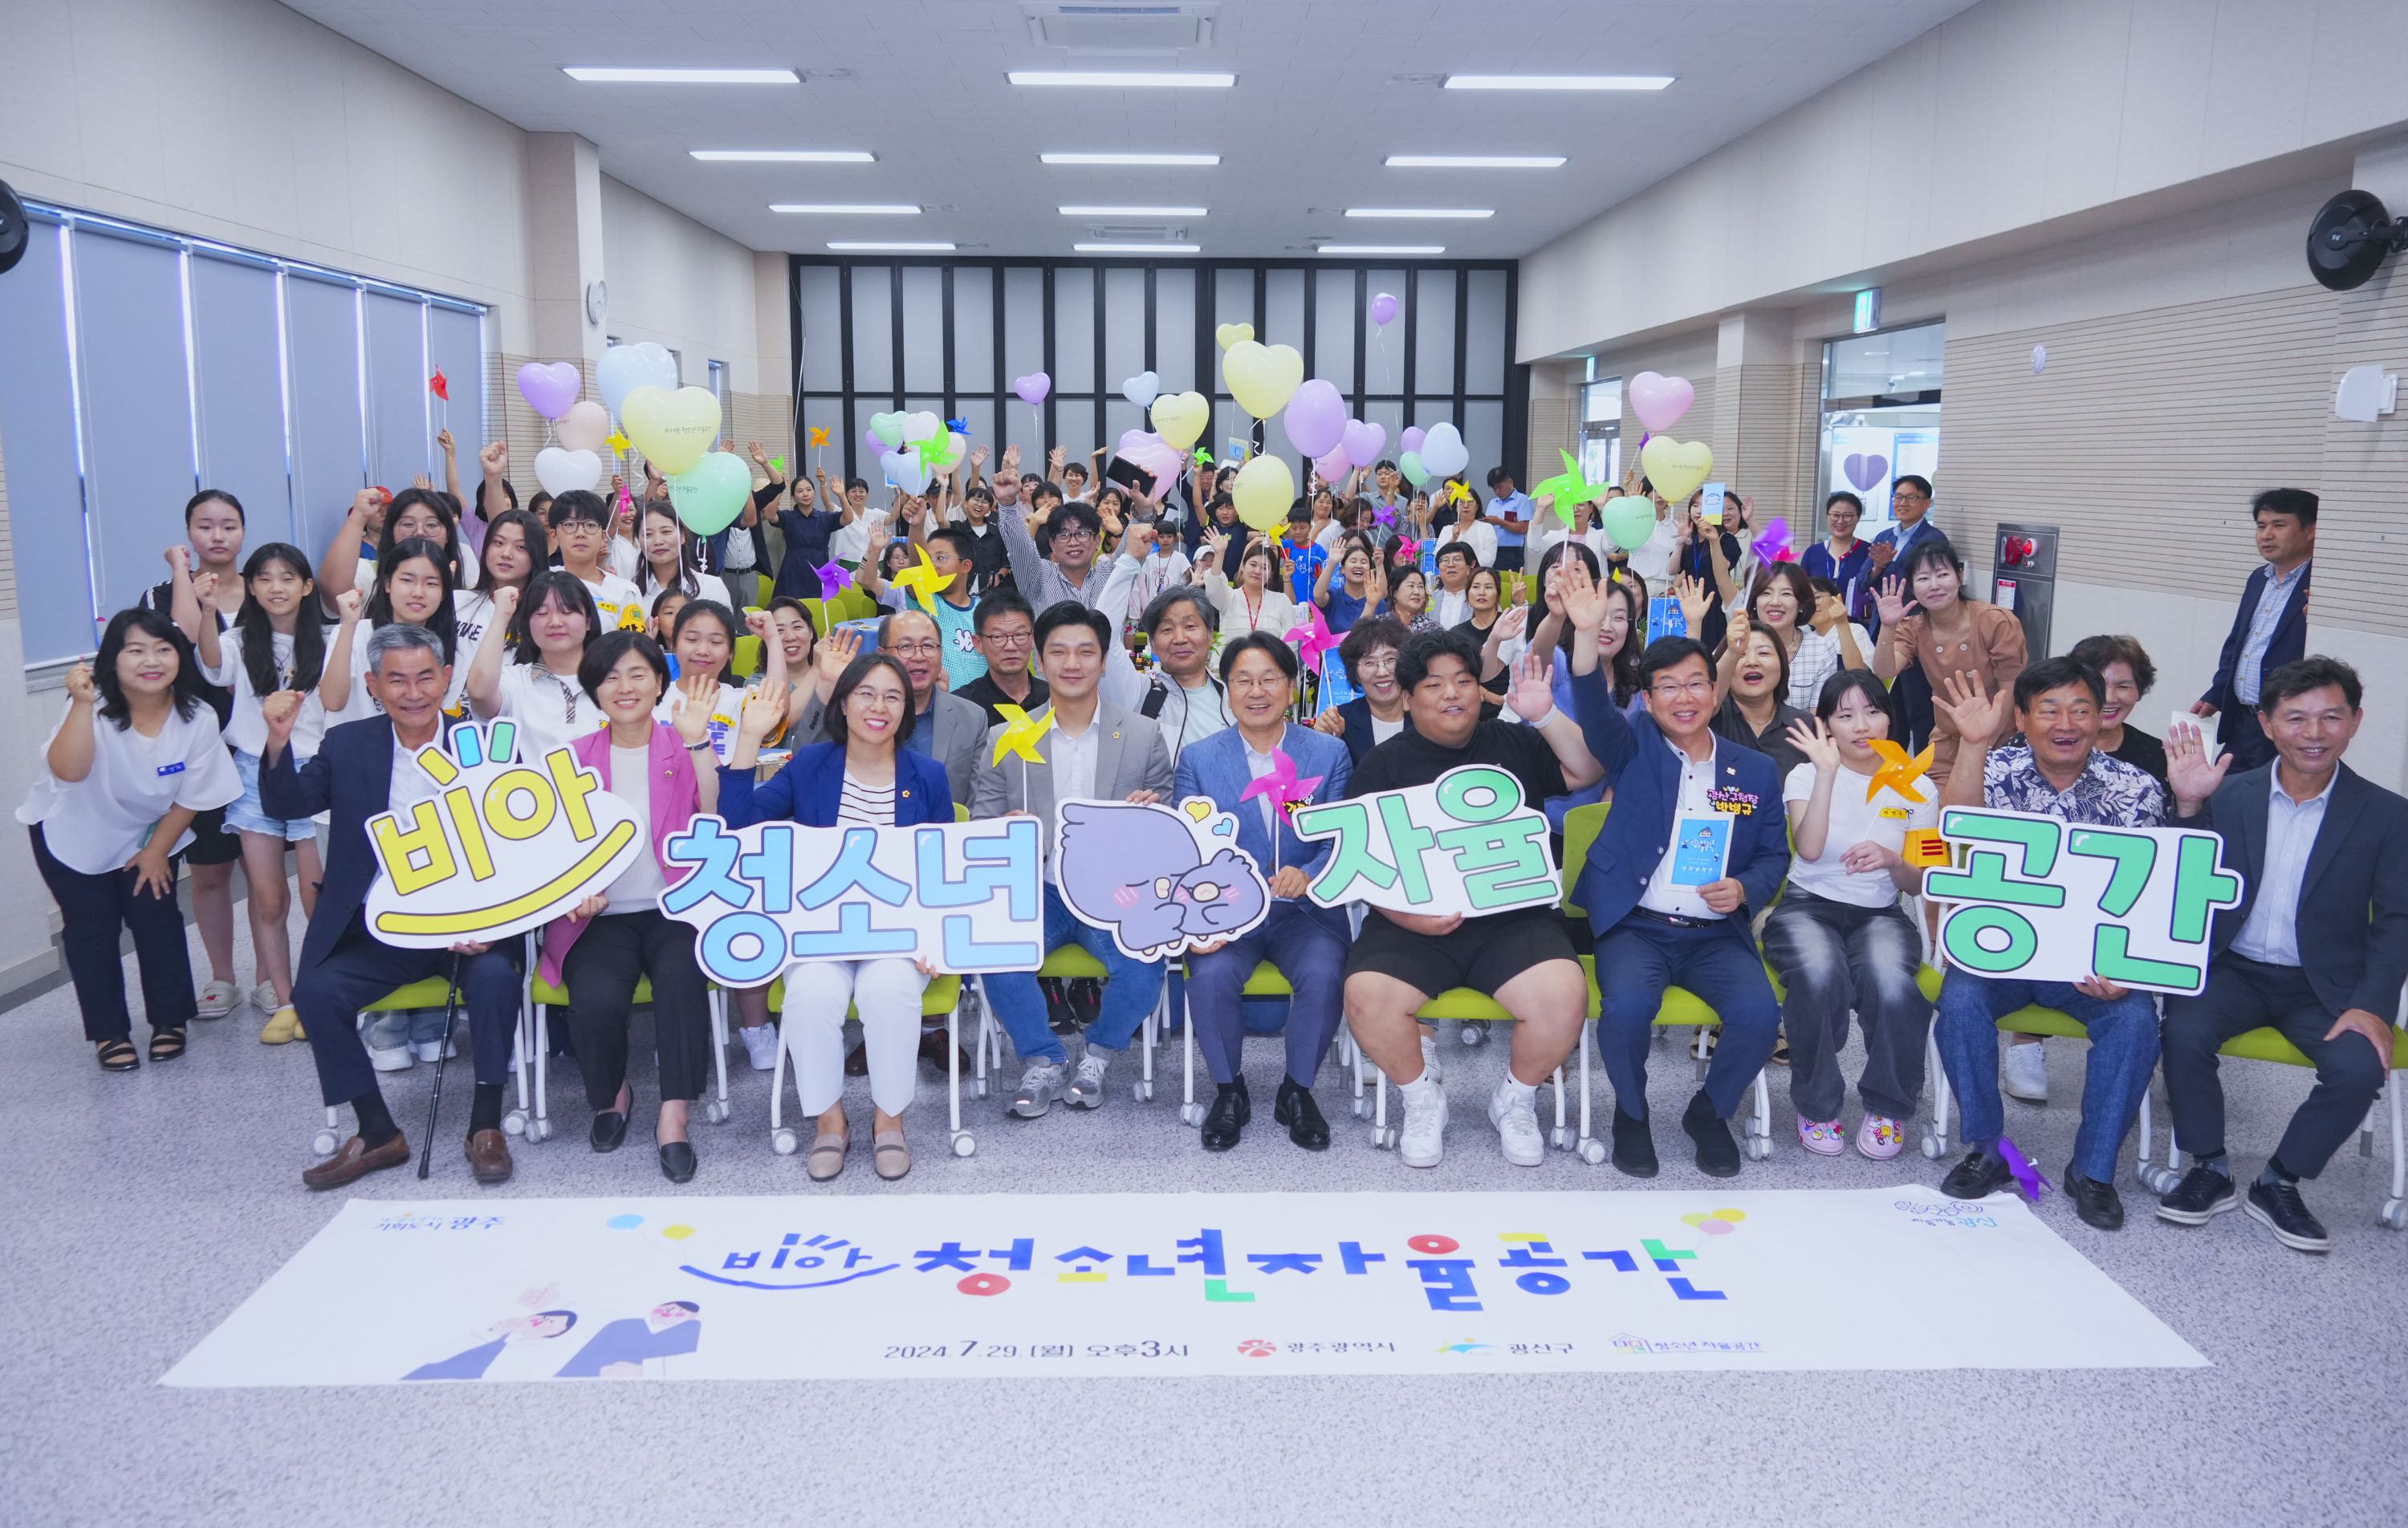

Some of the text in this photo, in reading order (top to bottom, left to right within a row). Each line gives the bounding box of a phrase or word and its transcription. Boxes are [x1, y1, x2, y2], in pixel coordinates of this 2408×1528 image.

[372, 747, 599, 895] 비아
[1296, 767, 1559, 910] 자율
[1715, 801, 1752, 815] 박병규
[664, 817, 1039, 984] 청소년
[1926, 809, 2239, 992] 공간
[722, 1233, 873, 1270] 비아
[1287, 1341, 1396, 1354] 광주광역시
[1508, 1342, 1575, 1355] 광산구
